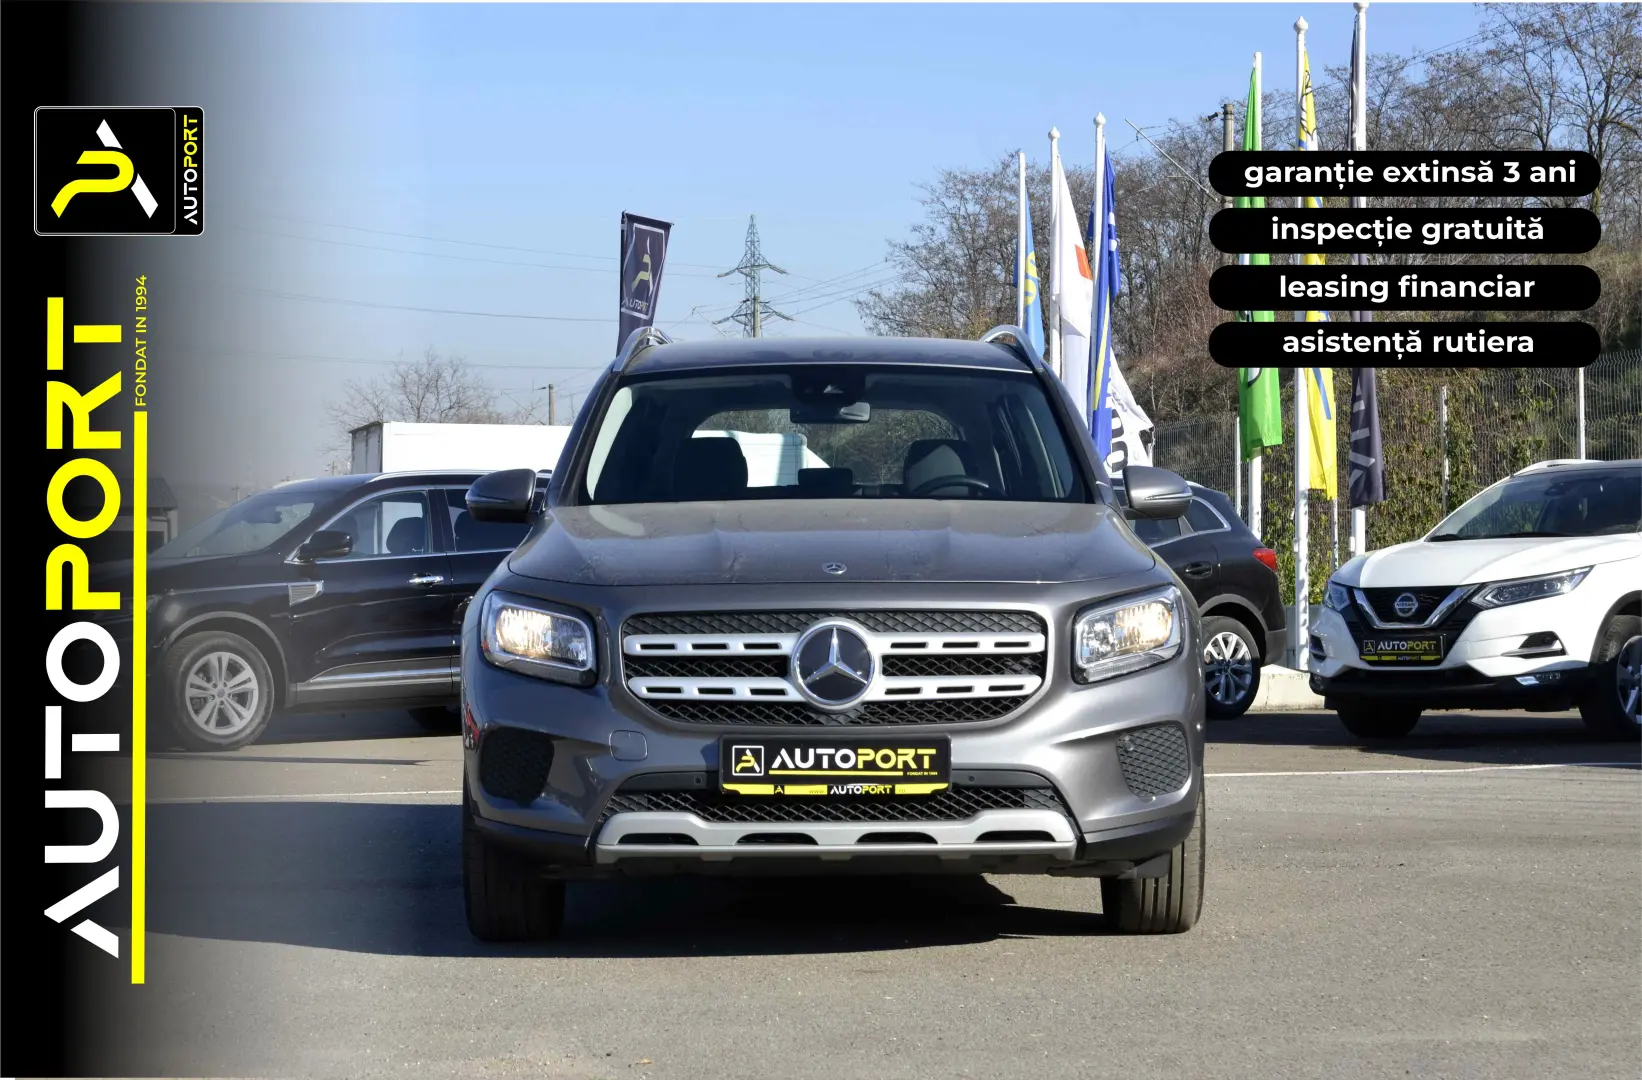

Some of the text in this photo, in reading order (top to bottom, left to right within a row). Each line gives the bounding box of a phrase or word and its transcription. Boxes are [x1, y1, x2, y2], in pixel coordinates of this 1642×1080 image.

[1377, 640, 1437, 651] AUTOPORT
[771, 747, 937, 769] AUTOPORT
[830, 785, 892, 795] AUTOPORT
